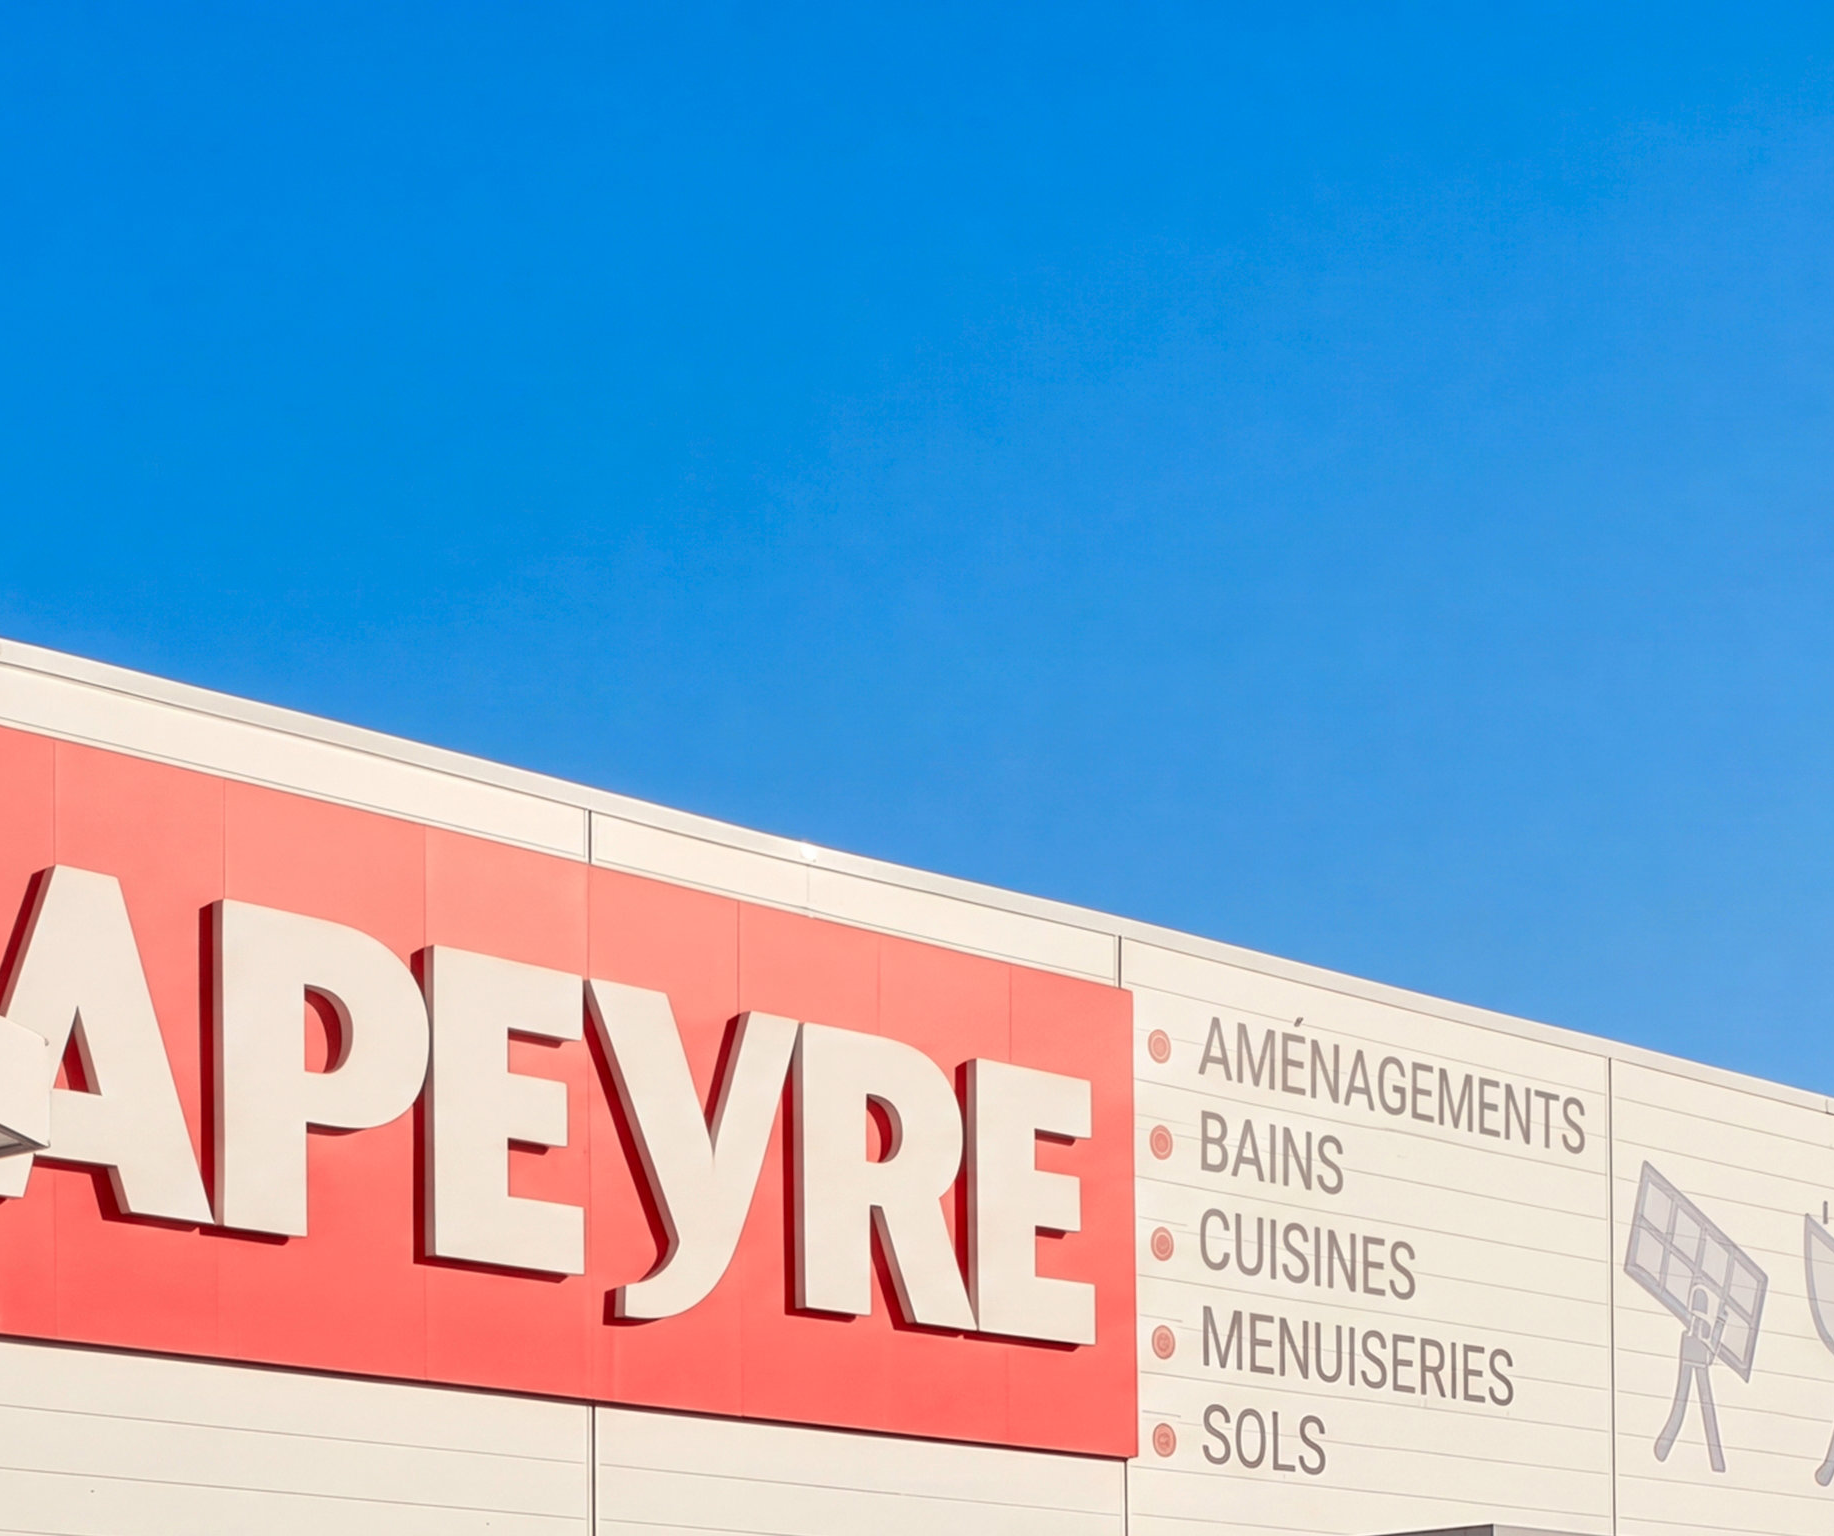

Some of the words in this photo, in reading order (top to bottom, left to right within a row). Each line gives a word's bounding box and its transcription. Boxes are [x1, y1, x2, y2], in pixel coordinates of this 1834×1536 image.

[1198, 1016, 1586, 1155] AMÉNAGEMENTS
[1200, 1109, 1345, 1195] BAINS
[1199, 1208, 1417, 1301] CUISINES
[1201, 1305, 1515, 1407] MENUISERIES
[1201, 1403, 1327, 1476] SOLS
